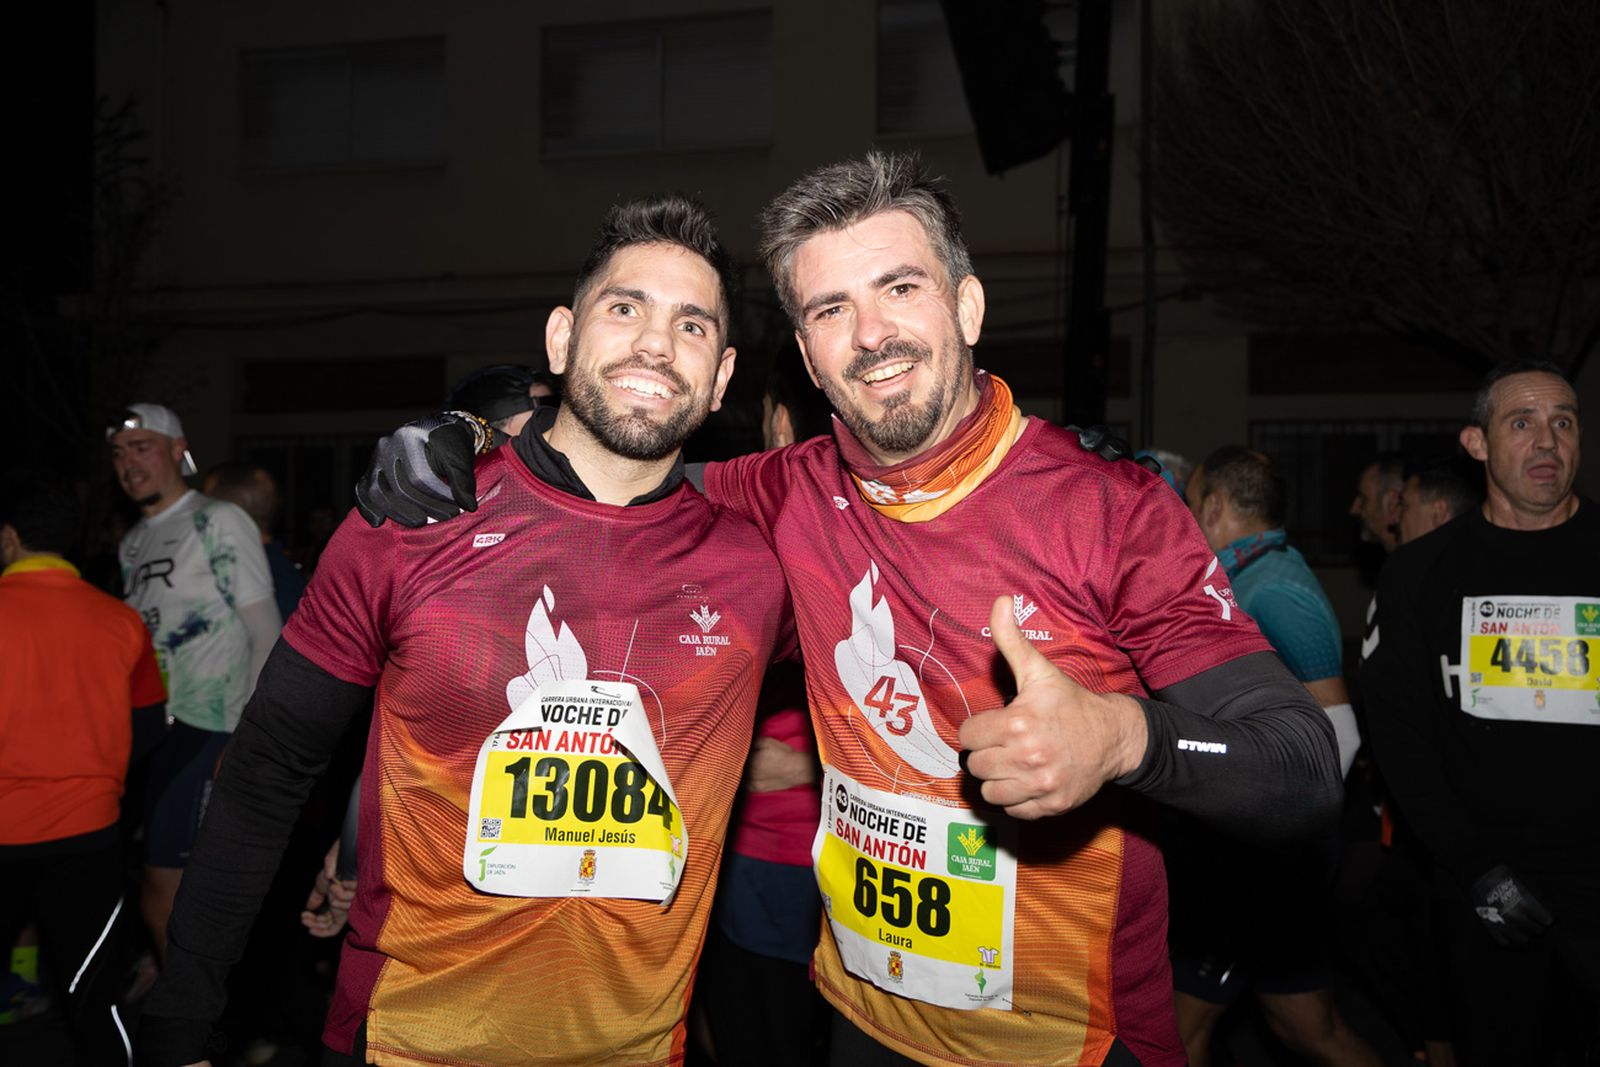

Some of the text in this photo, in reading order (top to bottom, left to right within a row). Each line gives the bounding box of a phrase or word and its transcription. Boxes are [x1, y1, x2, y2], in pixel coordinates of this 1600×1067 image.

[1496, 607, 1541, 619] NOCHE
[1544, 607, 1561, 620] DE
[1480, 619, 1560, 635] SAN ANTÓN
[679, 635, 731, 646] CAJA RURAL
[1490, 638, 1590, 676] 4458
[1526, 677, 1553, 687] David
[541, 696, 565, 704] CARRERA
[565, 697, 588, 705] URBANA
[863, 675, 921, 738] 43
[607, 708, 628, 727] D
[506, 728, 619, 755] SAN ANTÓ
[1177, 739, 1227, 754] BTWIN
[504, 757, 673, 832] 13084
[836, 788, 848, 808] 43
[849, 793, 927, 824] CARRERA URBANA INTERNACIONAL
[850, 802, 927, 844] NOCHE DE
[545, 827, 636, 844] Manuel Jesús
[836, 817, 927, 870] SAN ANTÓN
[853, 857, 951, 937] 658
[879, 928, 913, 949] Laura
